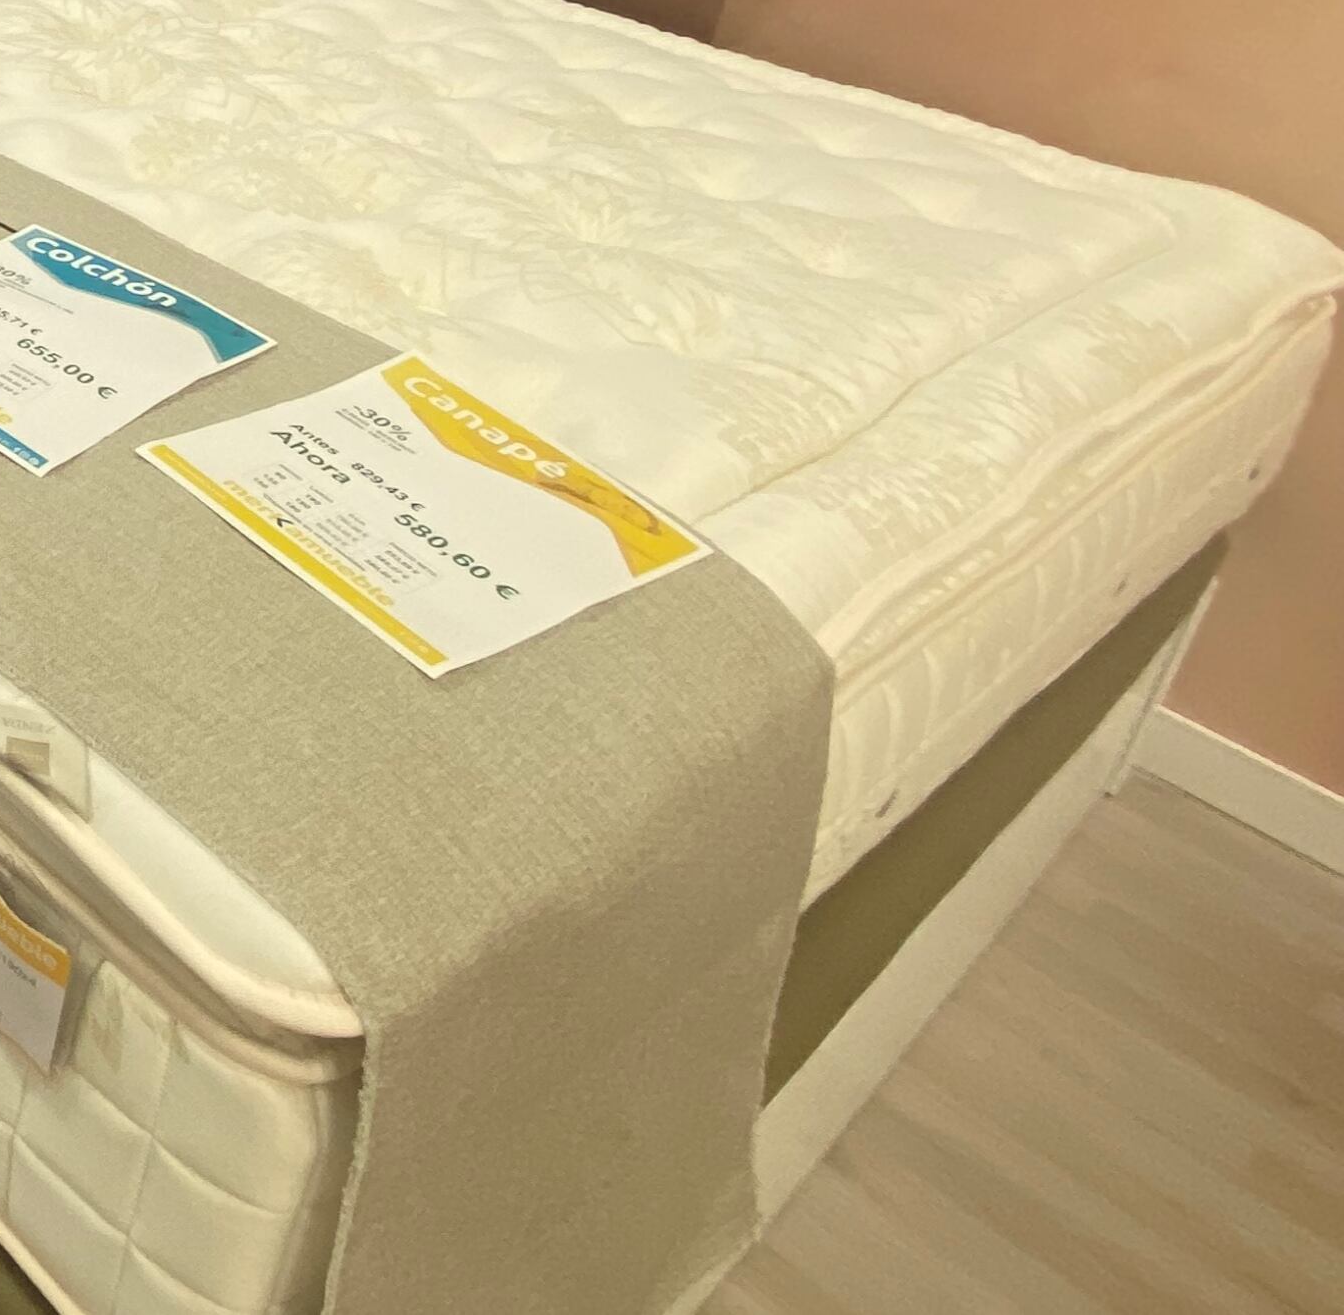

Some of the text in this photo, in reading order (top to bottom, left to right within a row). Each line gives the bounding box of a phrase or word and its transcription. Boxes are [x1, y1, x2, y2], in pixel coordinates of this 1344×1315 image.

[26, 237, 178, 308] Colchón
[30, 328, 43, 336] €
[17, 338, 94, 384] 655,00
[98, 386, 118, 399] €
[353, 406, 412, 441] -30%
[404, 377, 569, 478] Canapé
[289, 424, 339, 455] Antes
[351, 463, 409, 501] 829,43
[411, 502, 426, 512] €
[269, 431, 351, 484] Ahora
[394, 514, 491, 579] 580,60
[495, 585, 520, 600] €
